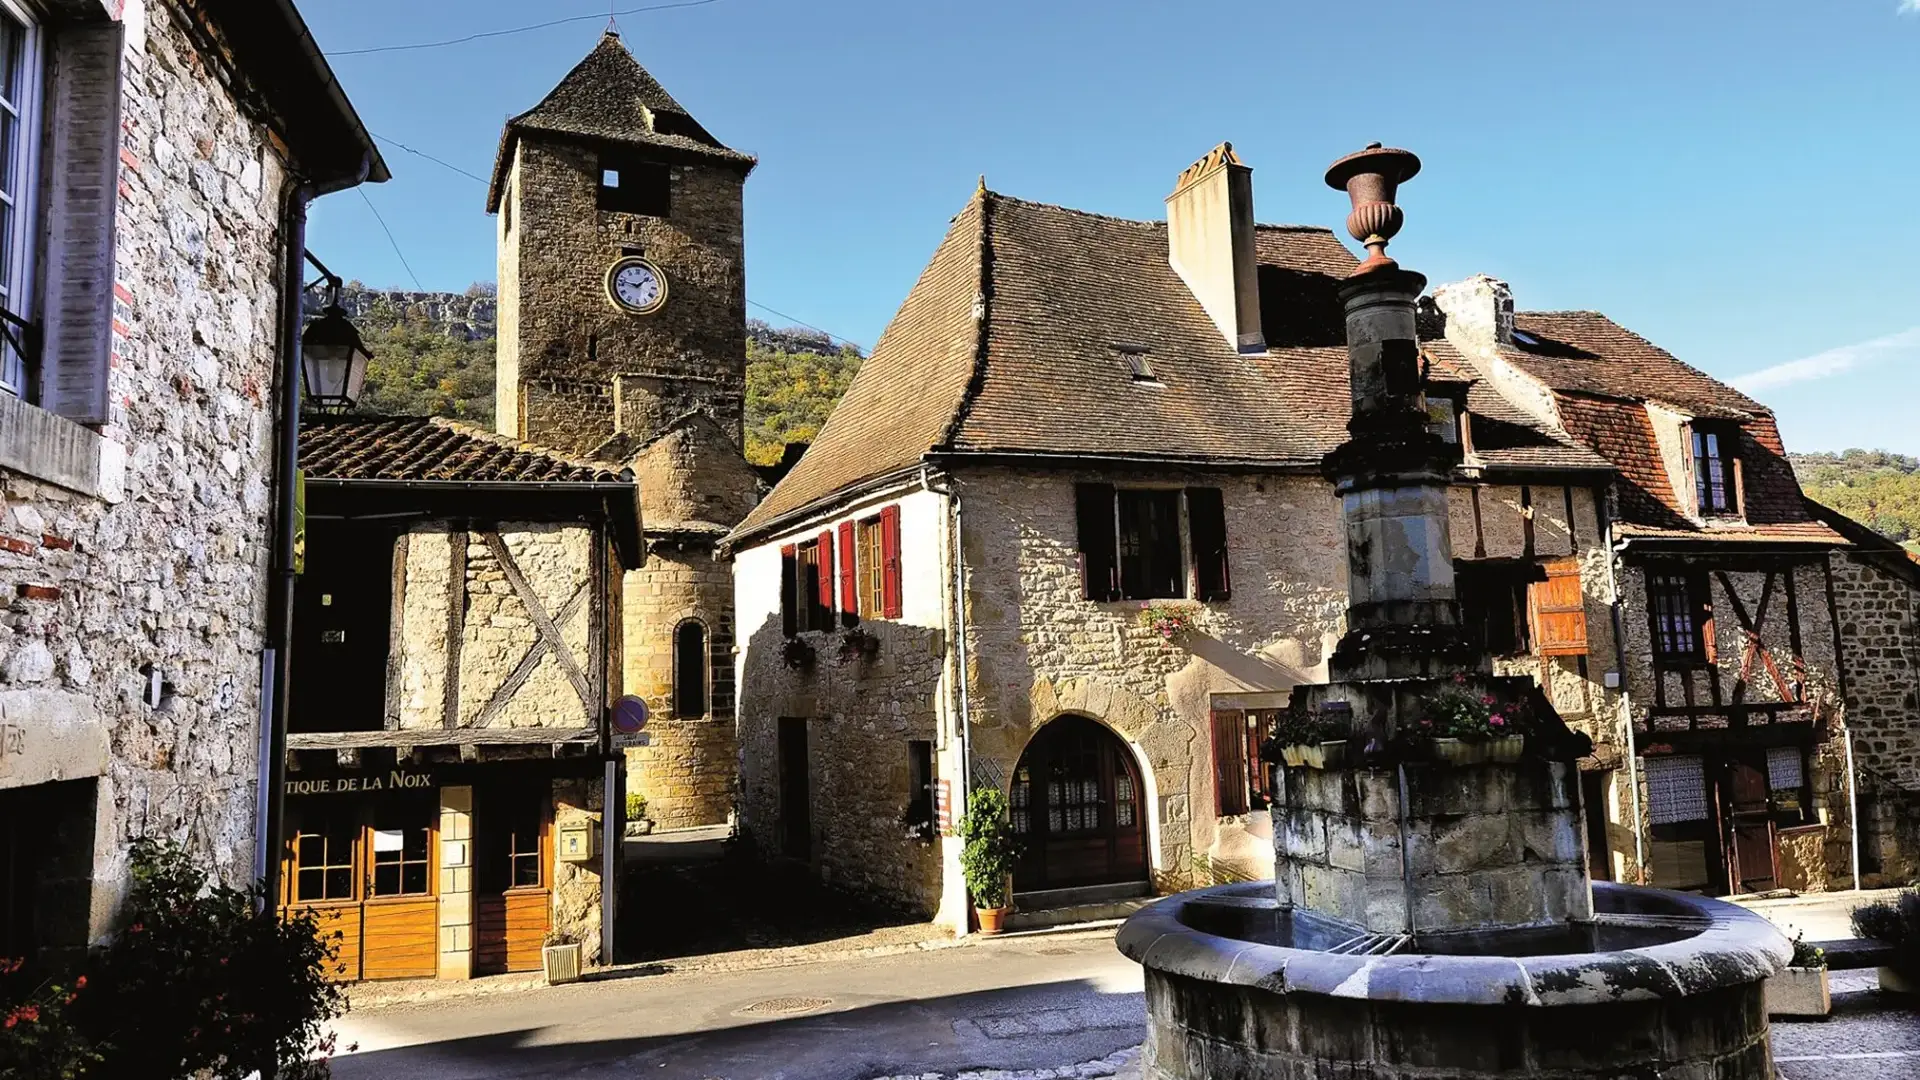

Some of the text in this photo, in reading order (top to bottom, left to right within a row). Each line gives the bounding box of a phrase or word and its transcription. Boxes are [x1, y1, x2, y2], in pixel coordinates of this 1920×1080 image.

[285, 780, 330, 794] TIQUE
[337, 778, 357, 791] DE
[362, 777, 382, 790] LA
